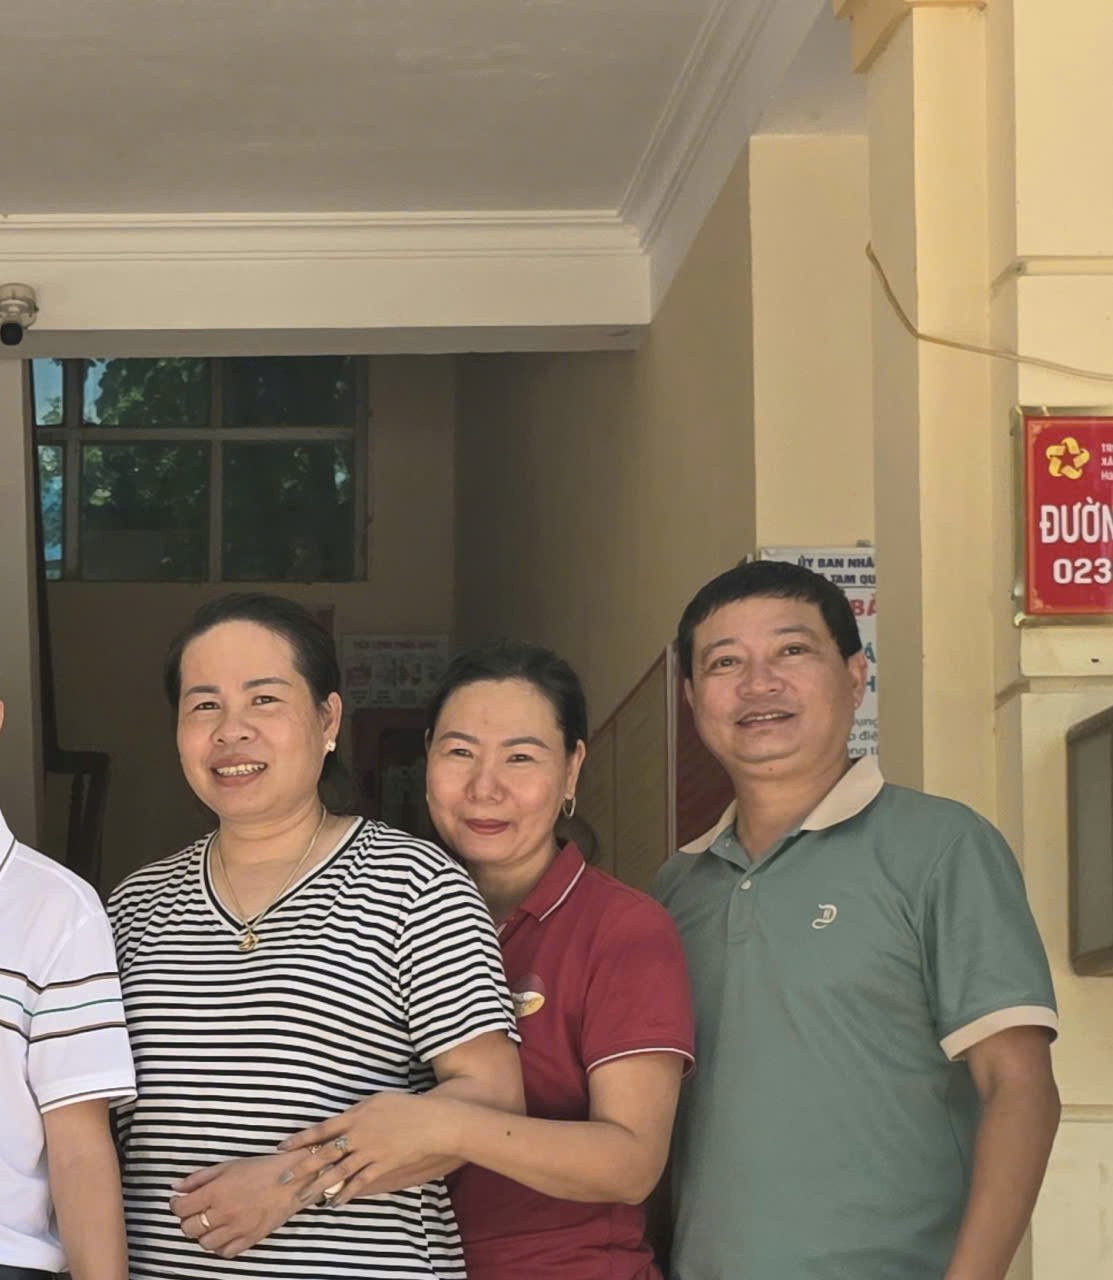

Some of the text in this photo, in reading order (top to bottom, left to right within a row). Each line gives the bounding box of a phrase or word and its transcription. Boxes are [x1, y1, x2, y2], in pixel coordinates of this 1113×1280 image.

[818, 558, 844, 568] BAN
[1053, 558, 1112, 584] 023
[831, 574, 856, 584] TAM
